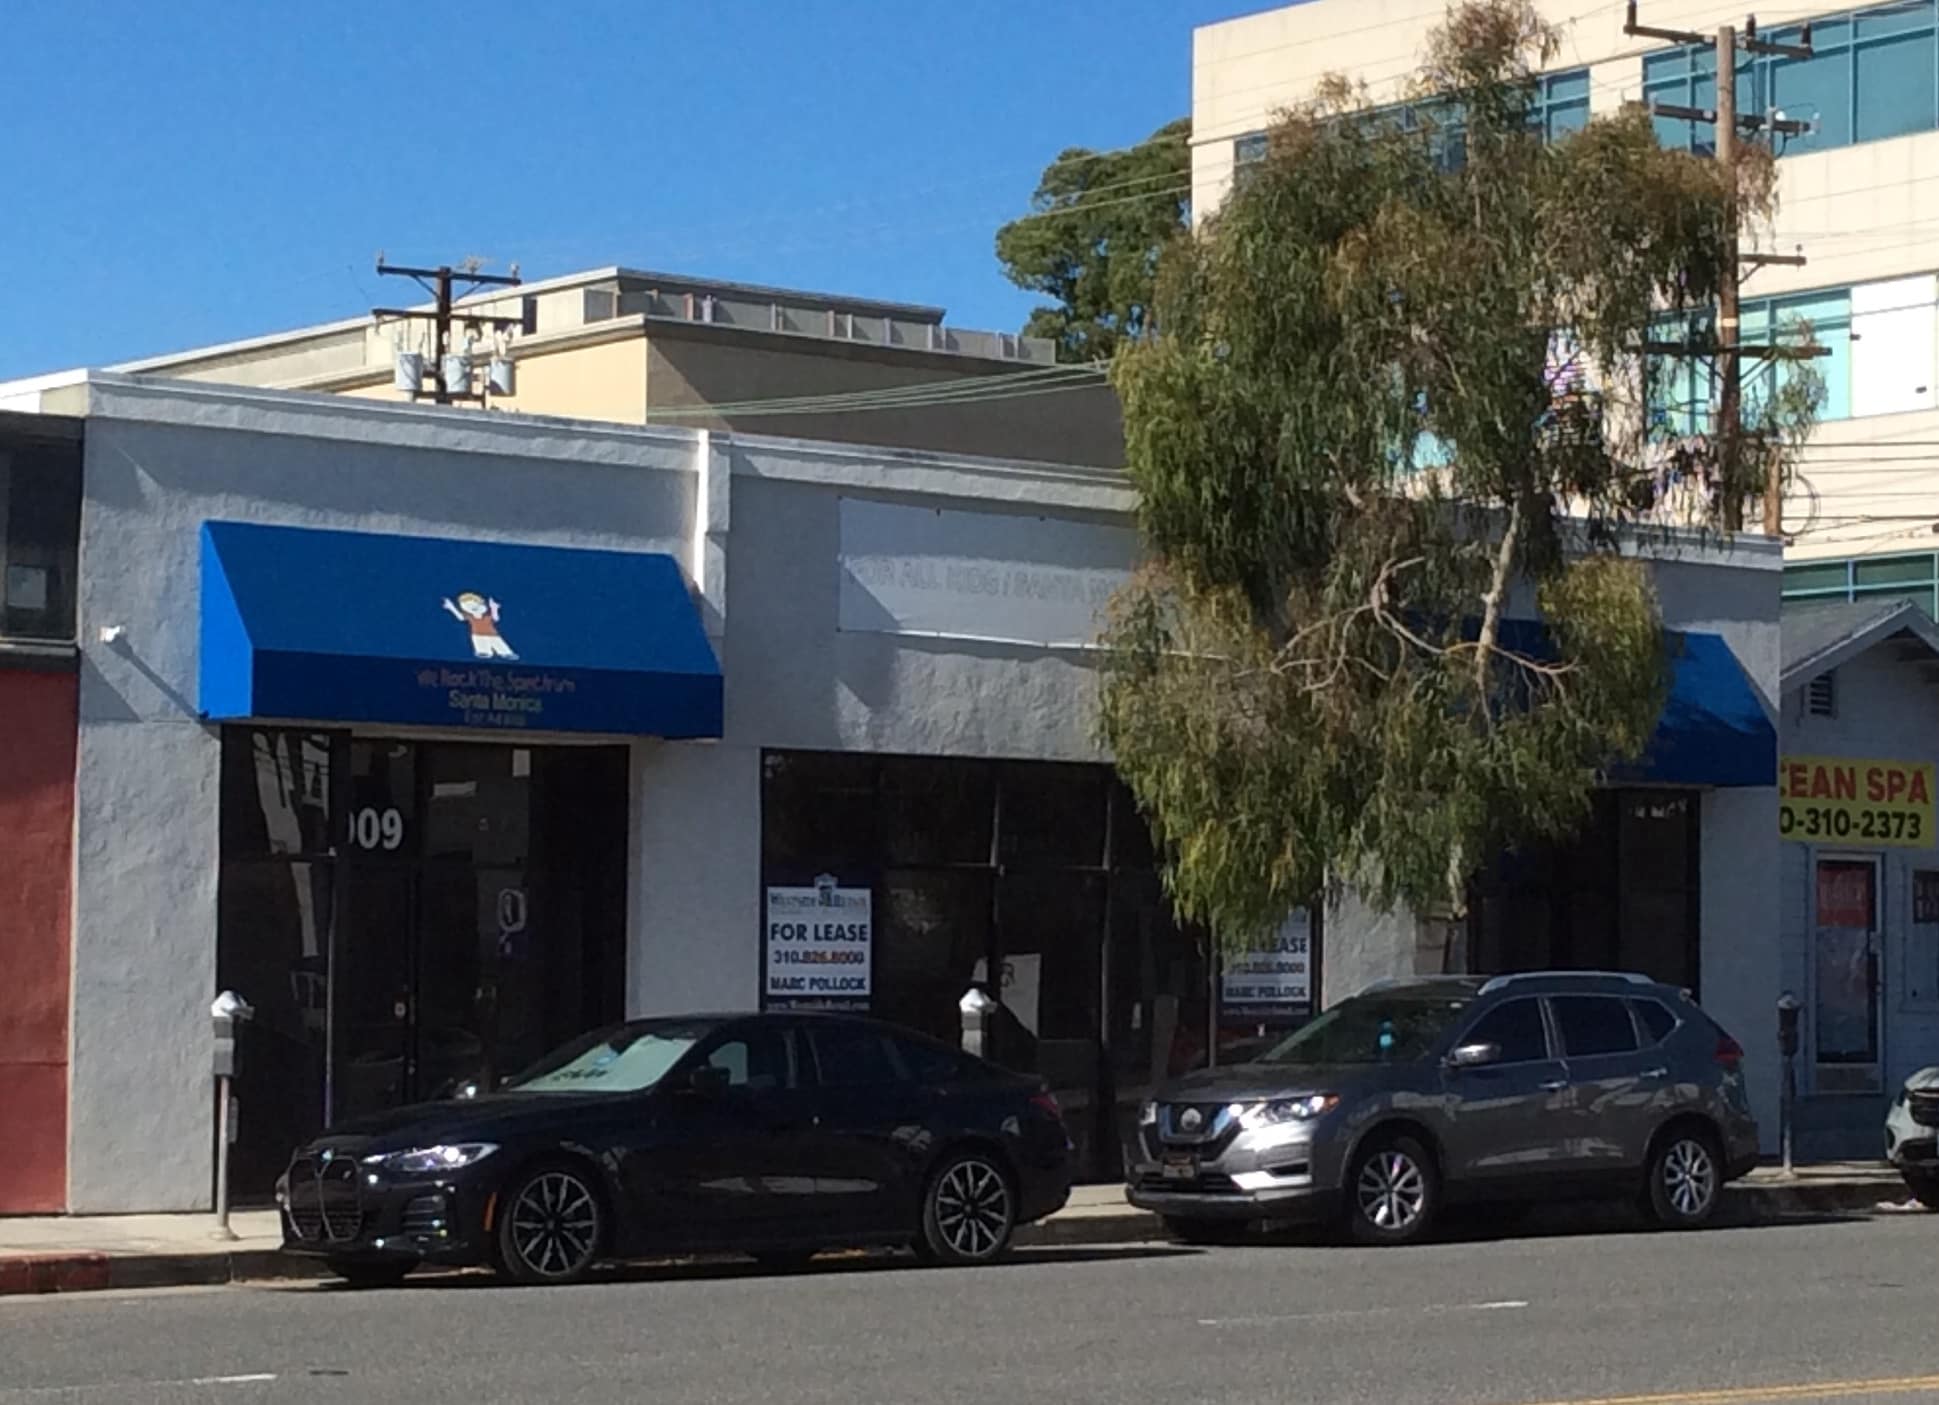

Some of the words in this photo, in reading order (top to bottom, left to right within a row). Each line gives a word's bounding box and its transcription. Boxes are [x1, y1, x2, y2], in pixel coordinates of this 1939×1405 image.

[478, 669, 504, 690] The
[448, 689, 490, 709] Santa
[492, 692, 544, 713] Monica
[1780, 763, 1857, 801] EAN
[1866, 767, 1930, 805] SPA
[348, 808, 403, 849] 09
[770, 923, 808, 941] FOR
[813, 924, 868, 942] LEASE
[770, 977, 806, 991] MARC
[808, 977, 866, 992] POLLOCK
